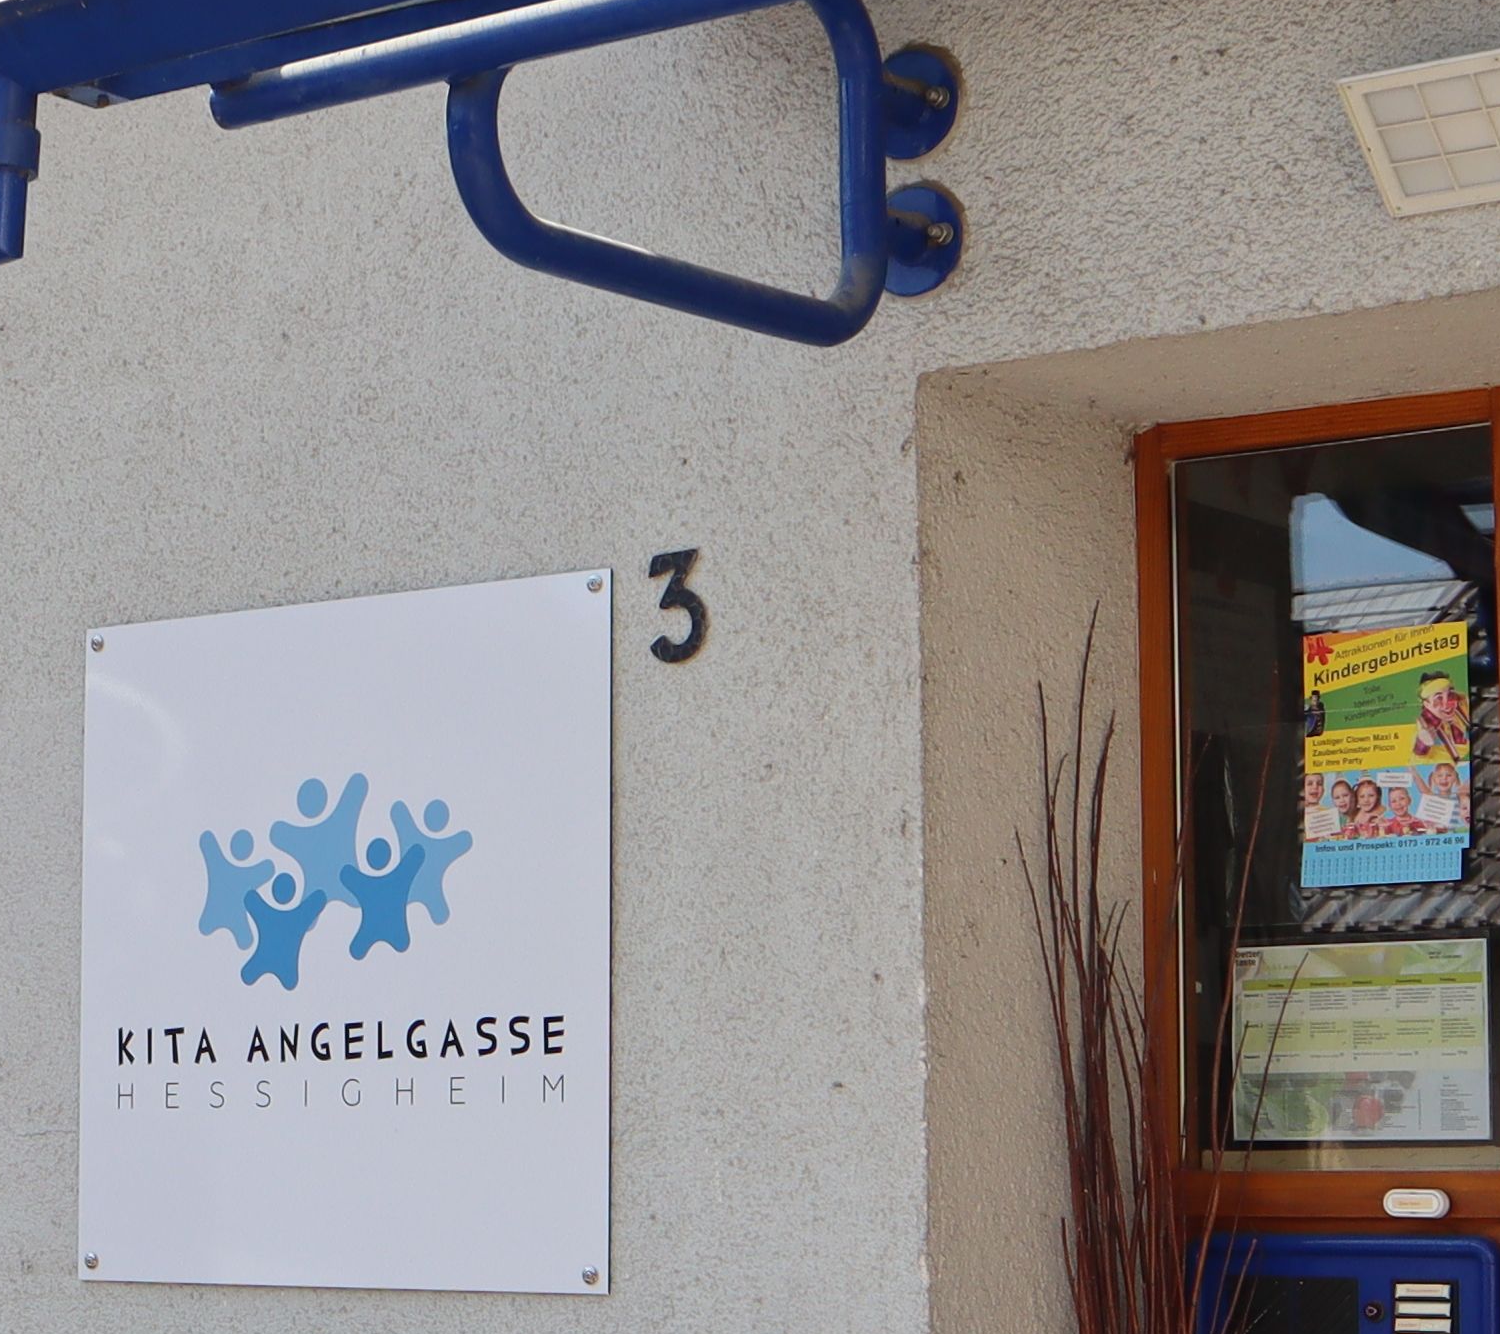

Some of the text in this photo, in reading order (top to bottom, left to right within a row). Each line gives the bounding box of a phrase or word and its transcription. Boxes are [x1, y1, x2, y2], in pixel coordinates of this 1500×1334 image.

[648, 549, 705, 664] 3
[1314, 634, 1460, 686] Kindergeburtstag
[1335, 625, 1434, 661] Attraktionen für Ihren
[1312, 736, 1343, 747] Lustiger
[1346, 735, 1370, 743] Clown
[1373, 733, 1391, 741] Maxi
[1312, 745, 1371, 757] Zauberkünstler
[1313, 759, 1324, 767] für
[1342, 757, 1363, 767] Party
[1316, 845, 1336, 853] Infos
[1338, 843, 1353, 851] und
[1398, 839, 1418, 848] 0173
[116, 1016, 566, 1066] KITA ANGELGASSE
[117, 1074, 566, 1110] HESSIGHEIM
